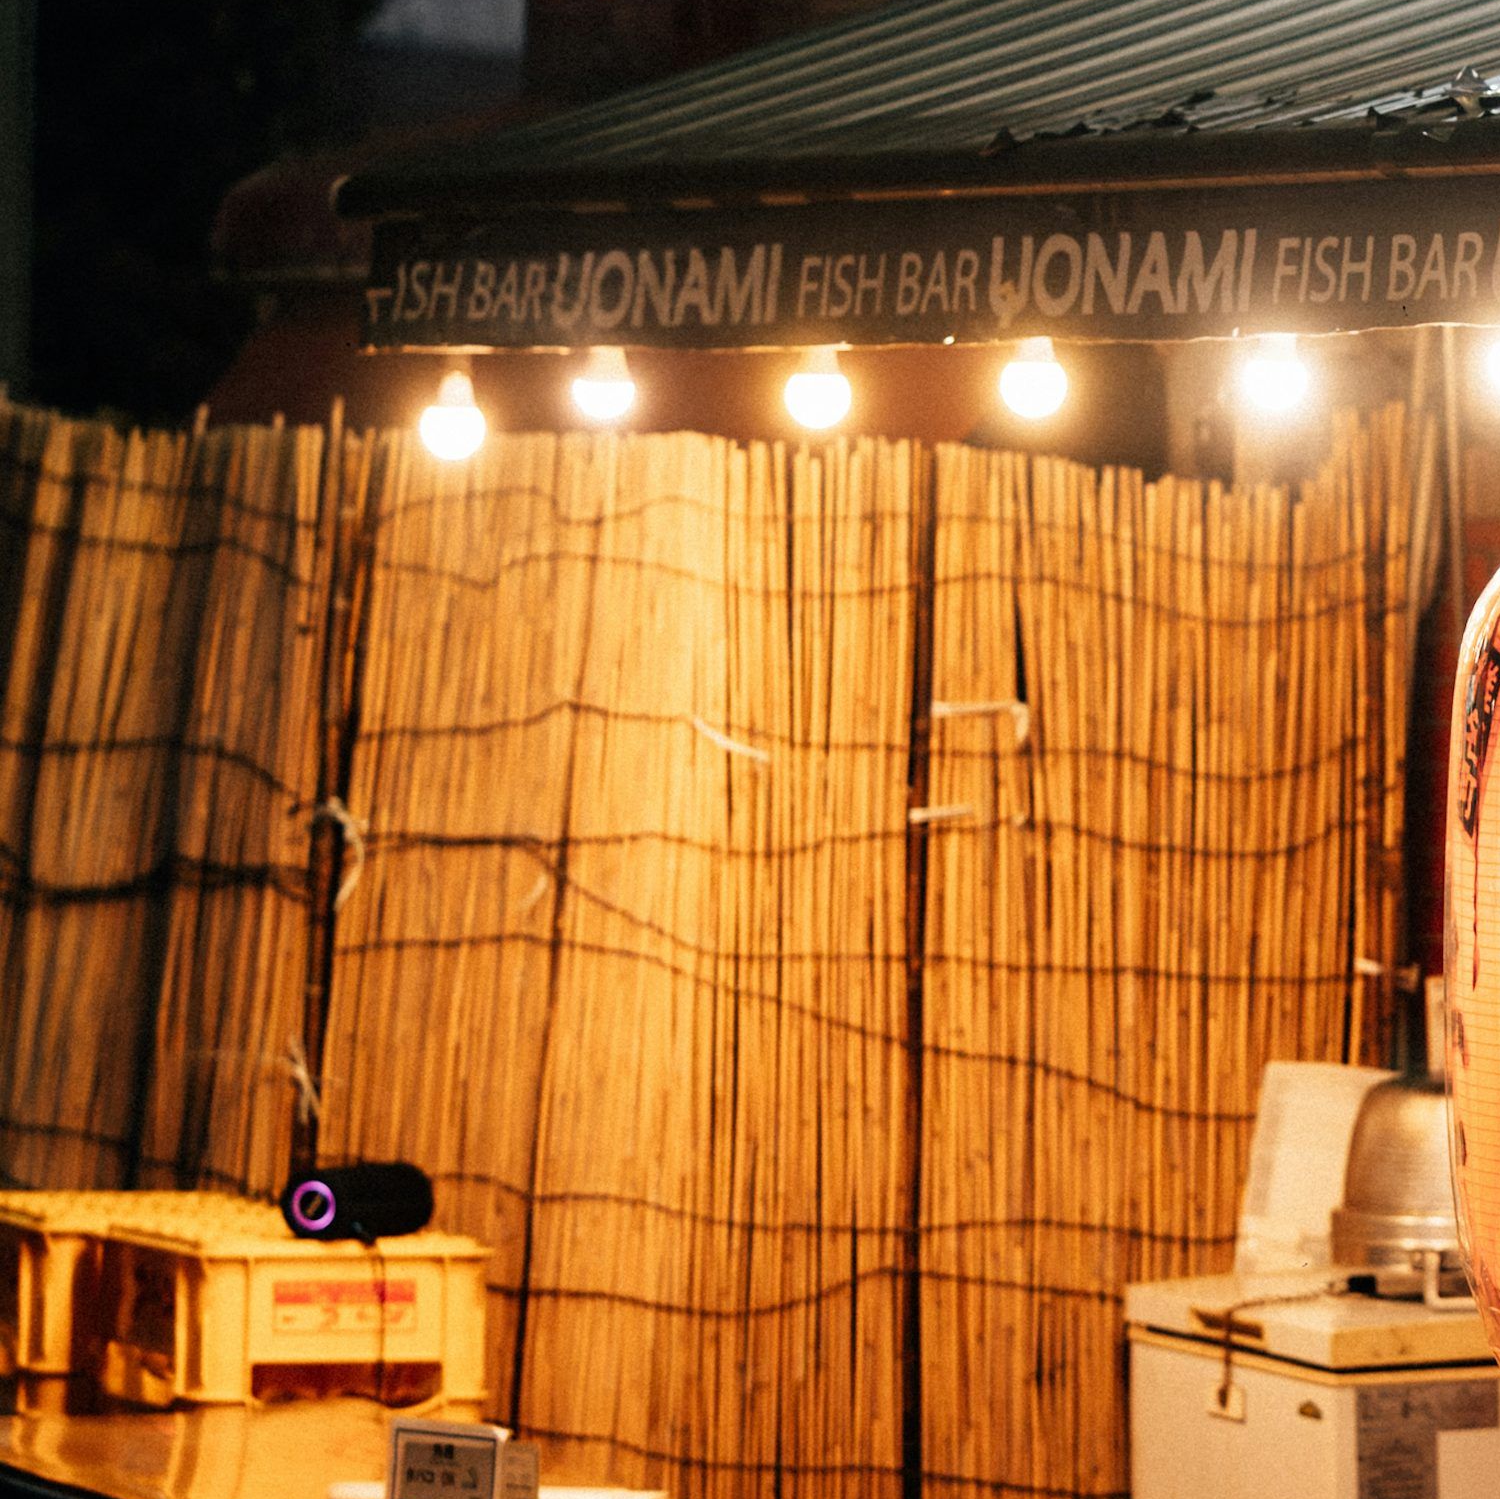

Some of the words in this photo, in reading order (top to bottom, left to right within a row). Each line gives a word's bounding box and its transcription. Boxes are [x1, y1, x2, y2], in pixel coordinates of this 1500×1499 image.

[467, 261, 546, 321] BAR
[550, 243, 783, 328] UONAMI
[798, 254, 887, 317] FISH
[897, 250, 978, 315] BAR
[989, 228, 1256, 320] UONAMI
[1272, 236, 1374, 302] FISH
[1387, 232, 1484, 301] BAR
